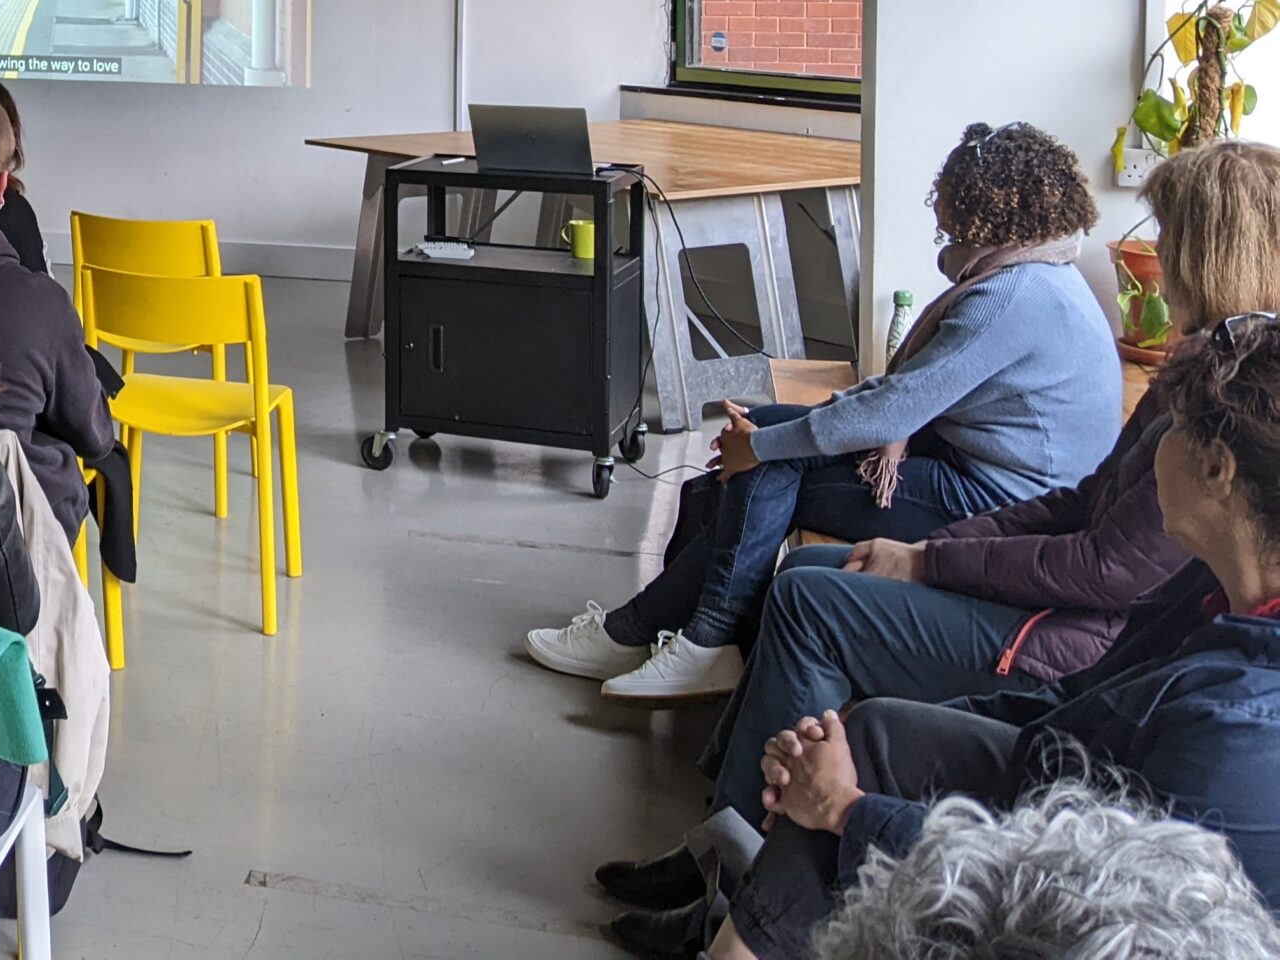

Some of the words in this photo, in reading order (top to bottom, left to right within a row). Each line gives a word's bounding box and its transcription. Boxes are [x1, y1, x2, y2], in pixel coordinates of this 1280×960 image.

[28, 58, 47, 71] the
[51, 60, 75, 74] way
[78, 59, 90, 72] to
[93, 59, 119, 72] love
